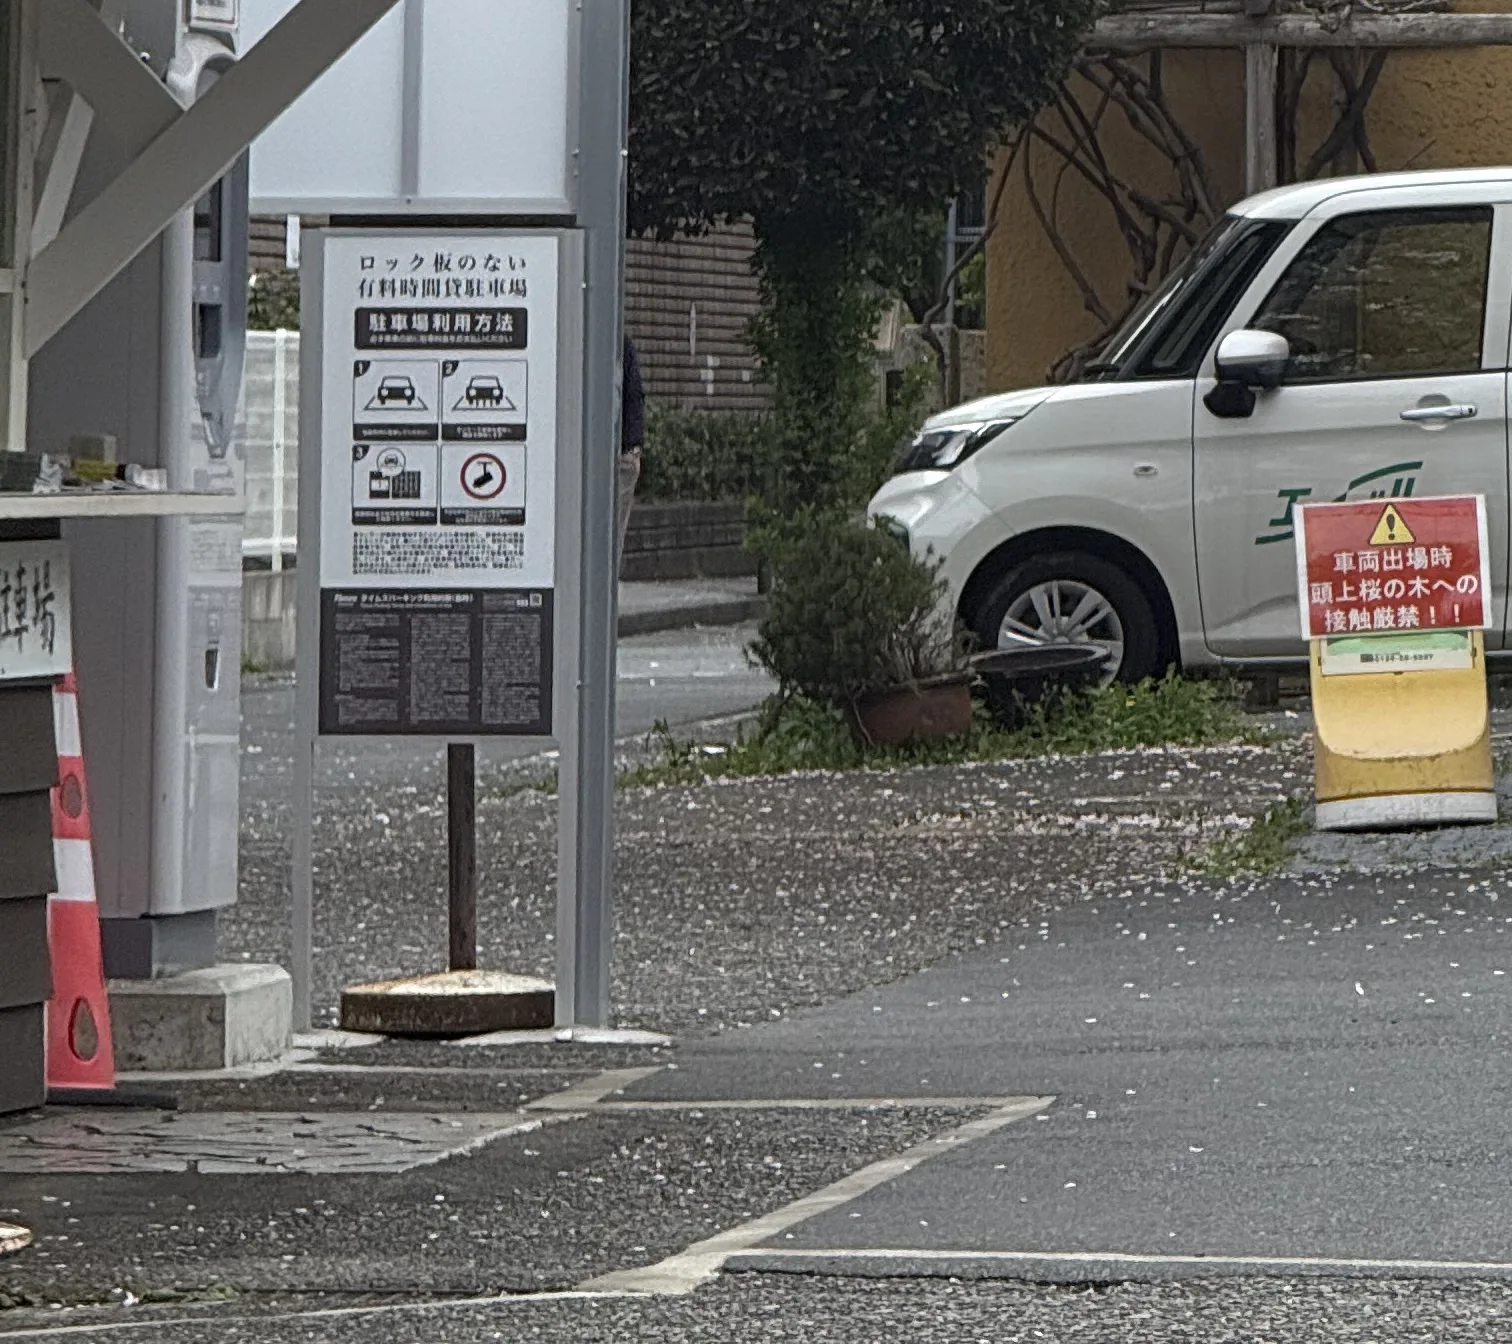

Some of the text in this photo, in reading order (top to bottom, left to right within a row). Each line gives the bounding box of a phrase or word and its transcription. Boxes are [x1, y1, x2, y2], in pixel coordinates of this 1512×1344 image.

[359, 251, 527, 273] ロック板のない
[358, 276, 528, 299] 有料時間貸駐車場
[368, 312, 514, 333] 駐車場利用方法
[1333, 545, 1453, 575] 車両出場時
[1309, 574, 1479, 606] 頭上桜の木への
[1324, 603, 1461, 634] 接触厳禁！！
